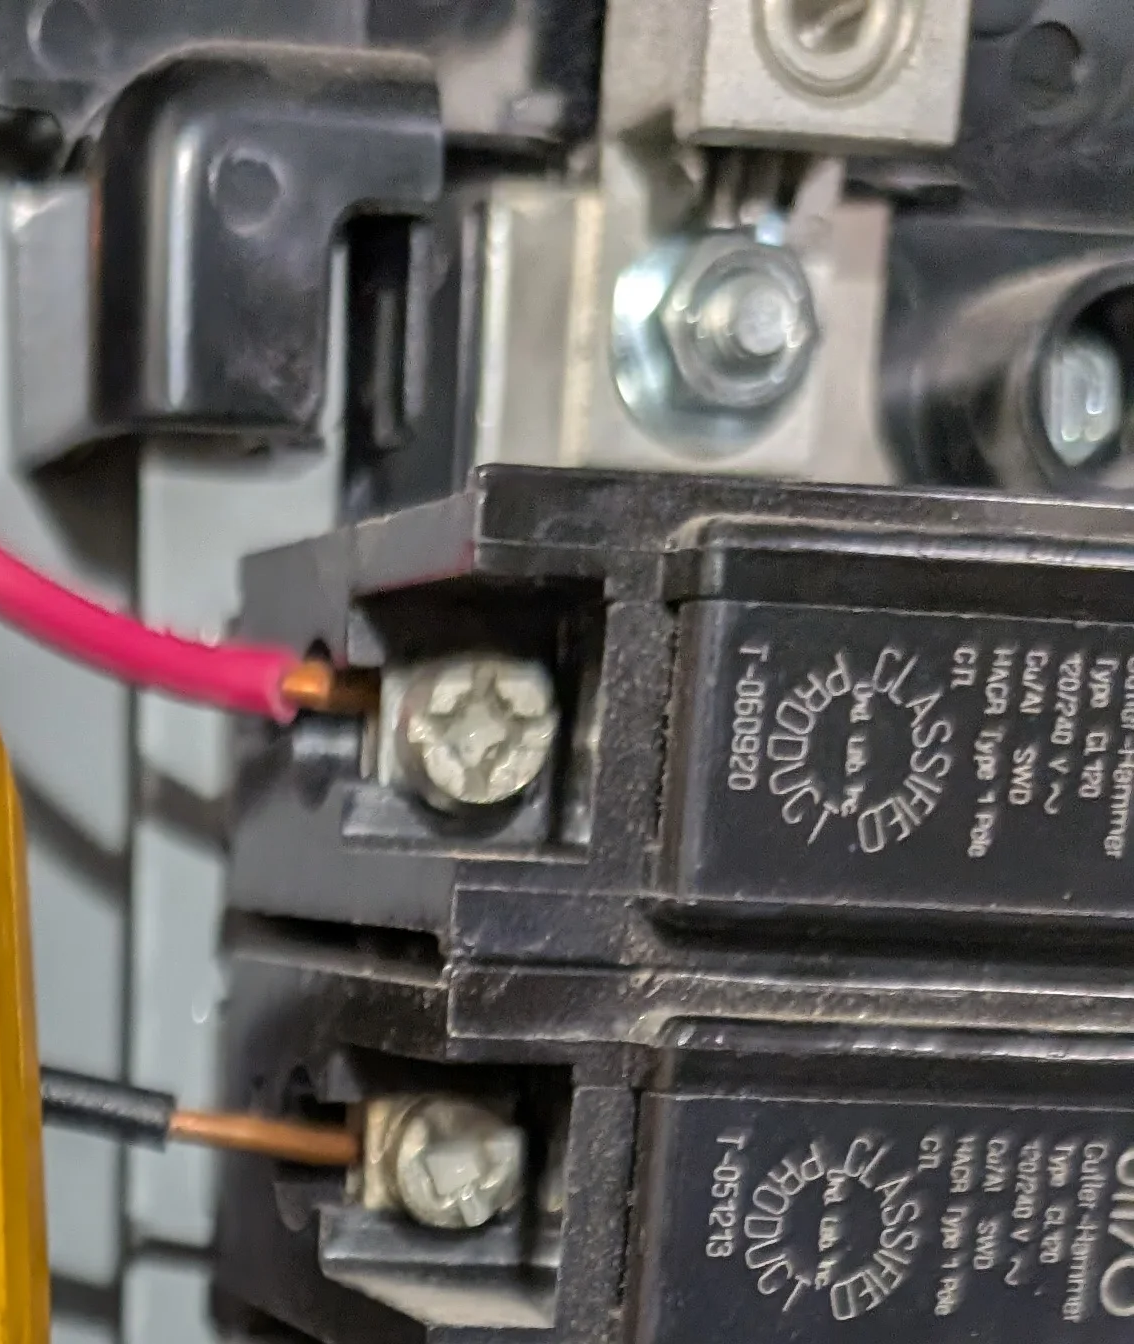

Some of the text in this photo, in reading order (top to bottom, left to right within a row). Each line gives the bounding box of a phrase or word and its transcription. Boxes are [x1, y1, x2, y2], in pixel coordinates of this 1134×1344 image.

[727, 641, 770, 791] T-060920
[767, 651, 852, 846] PRODUCT
[856, 644, 952, 854] CLASSIFIED
[705, 1127, 748, 1258] T-051213
[743, 1138, 824, 1313] PRODUCT
[829, 1136, 922, 1320] CLASSIFIED
